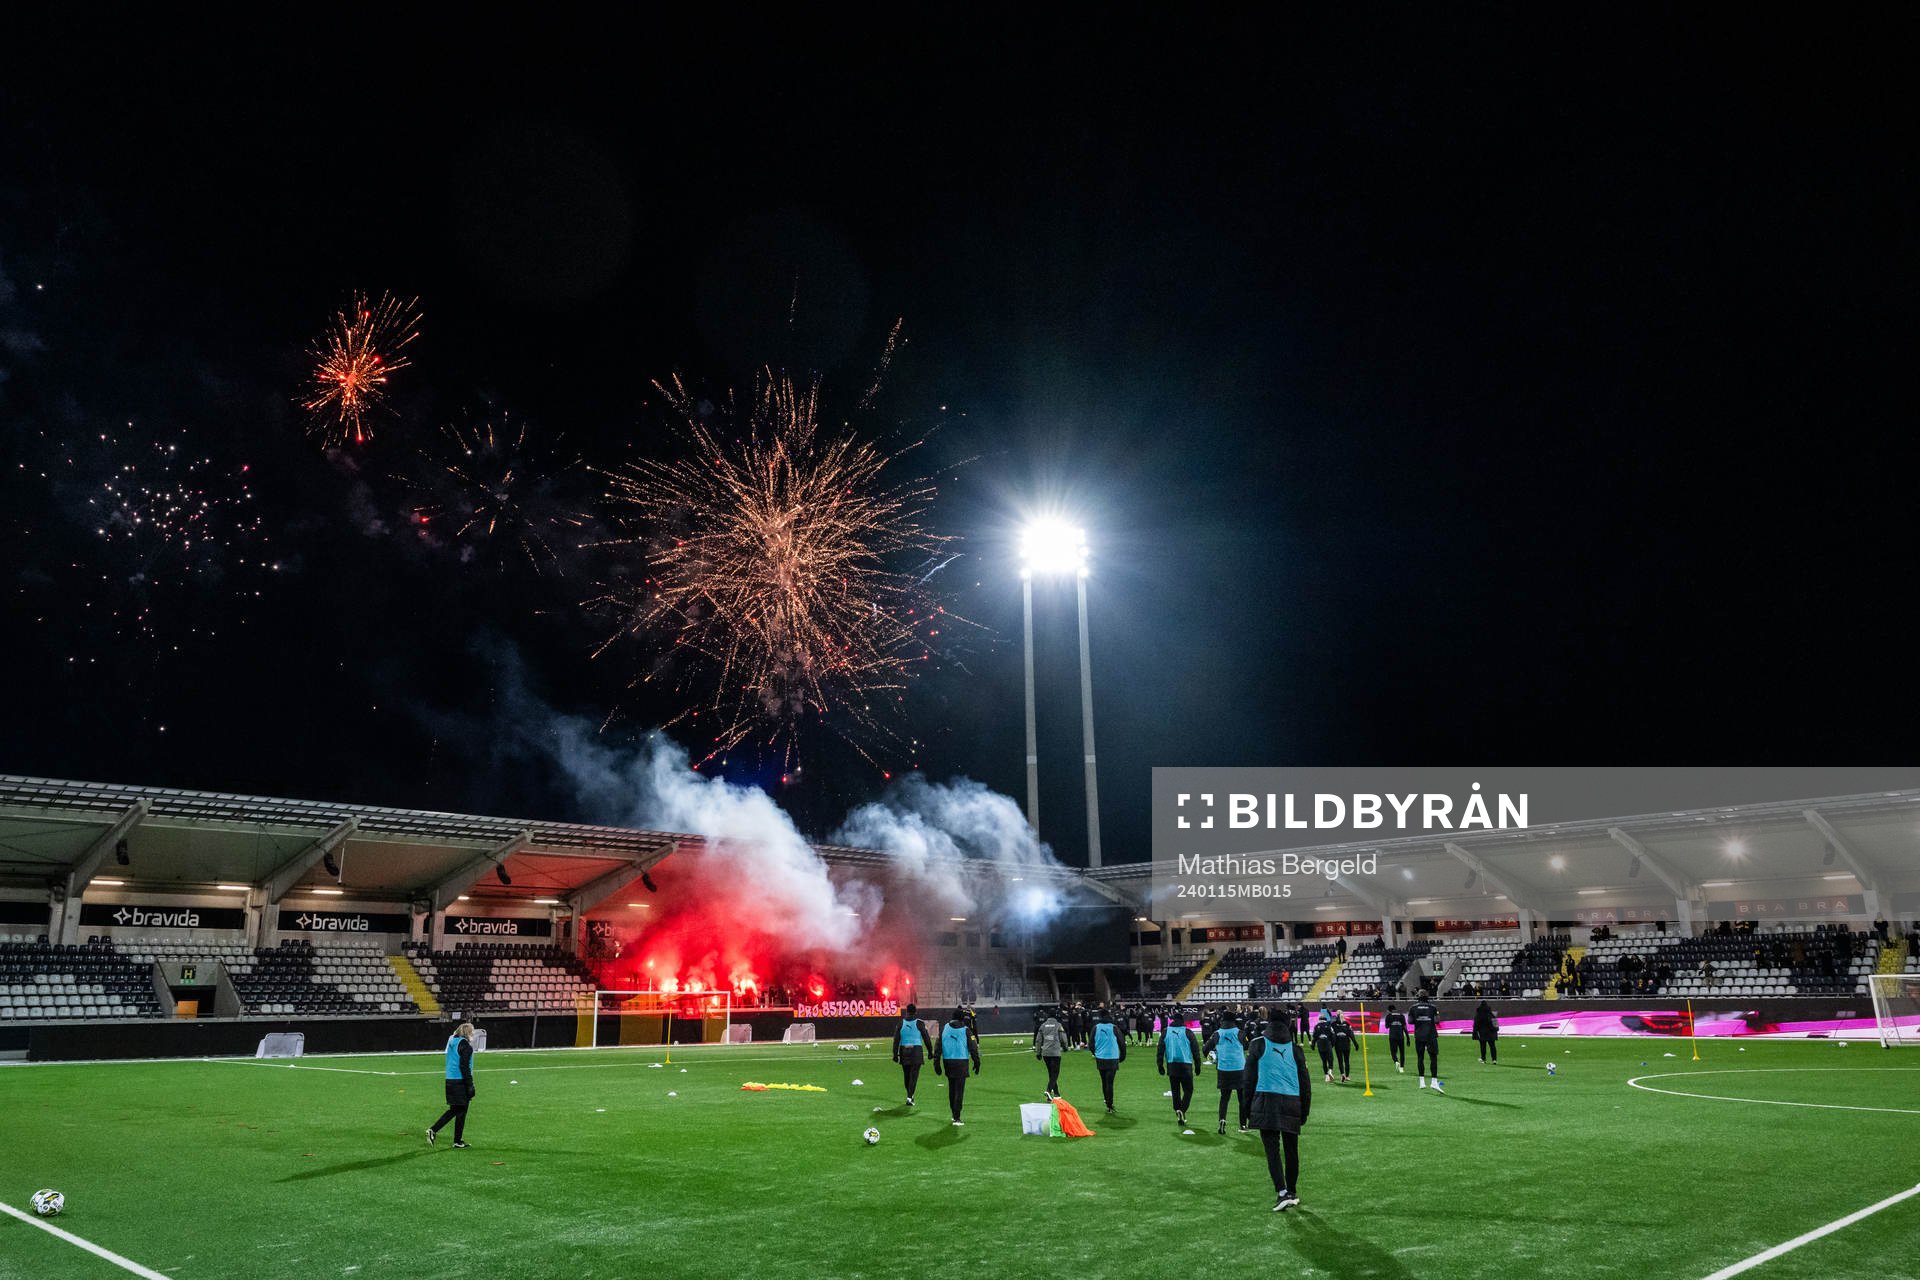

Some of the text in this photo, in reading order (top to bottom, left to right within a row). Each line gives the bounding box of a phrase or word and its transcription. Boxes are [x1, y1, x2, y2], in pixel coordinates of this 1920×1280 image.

[1739, 903, 1786, 913] BRA
[1798, 900, 1847, 910] BRA
[132, 907, 200, 927] bravida
[312, 913, 369, 931] bravida
[469, 918, 518, 935] bravida
[1435, 963, 1441, 971] F
[184, 969, 193, 979] H
